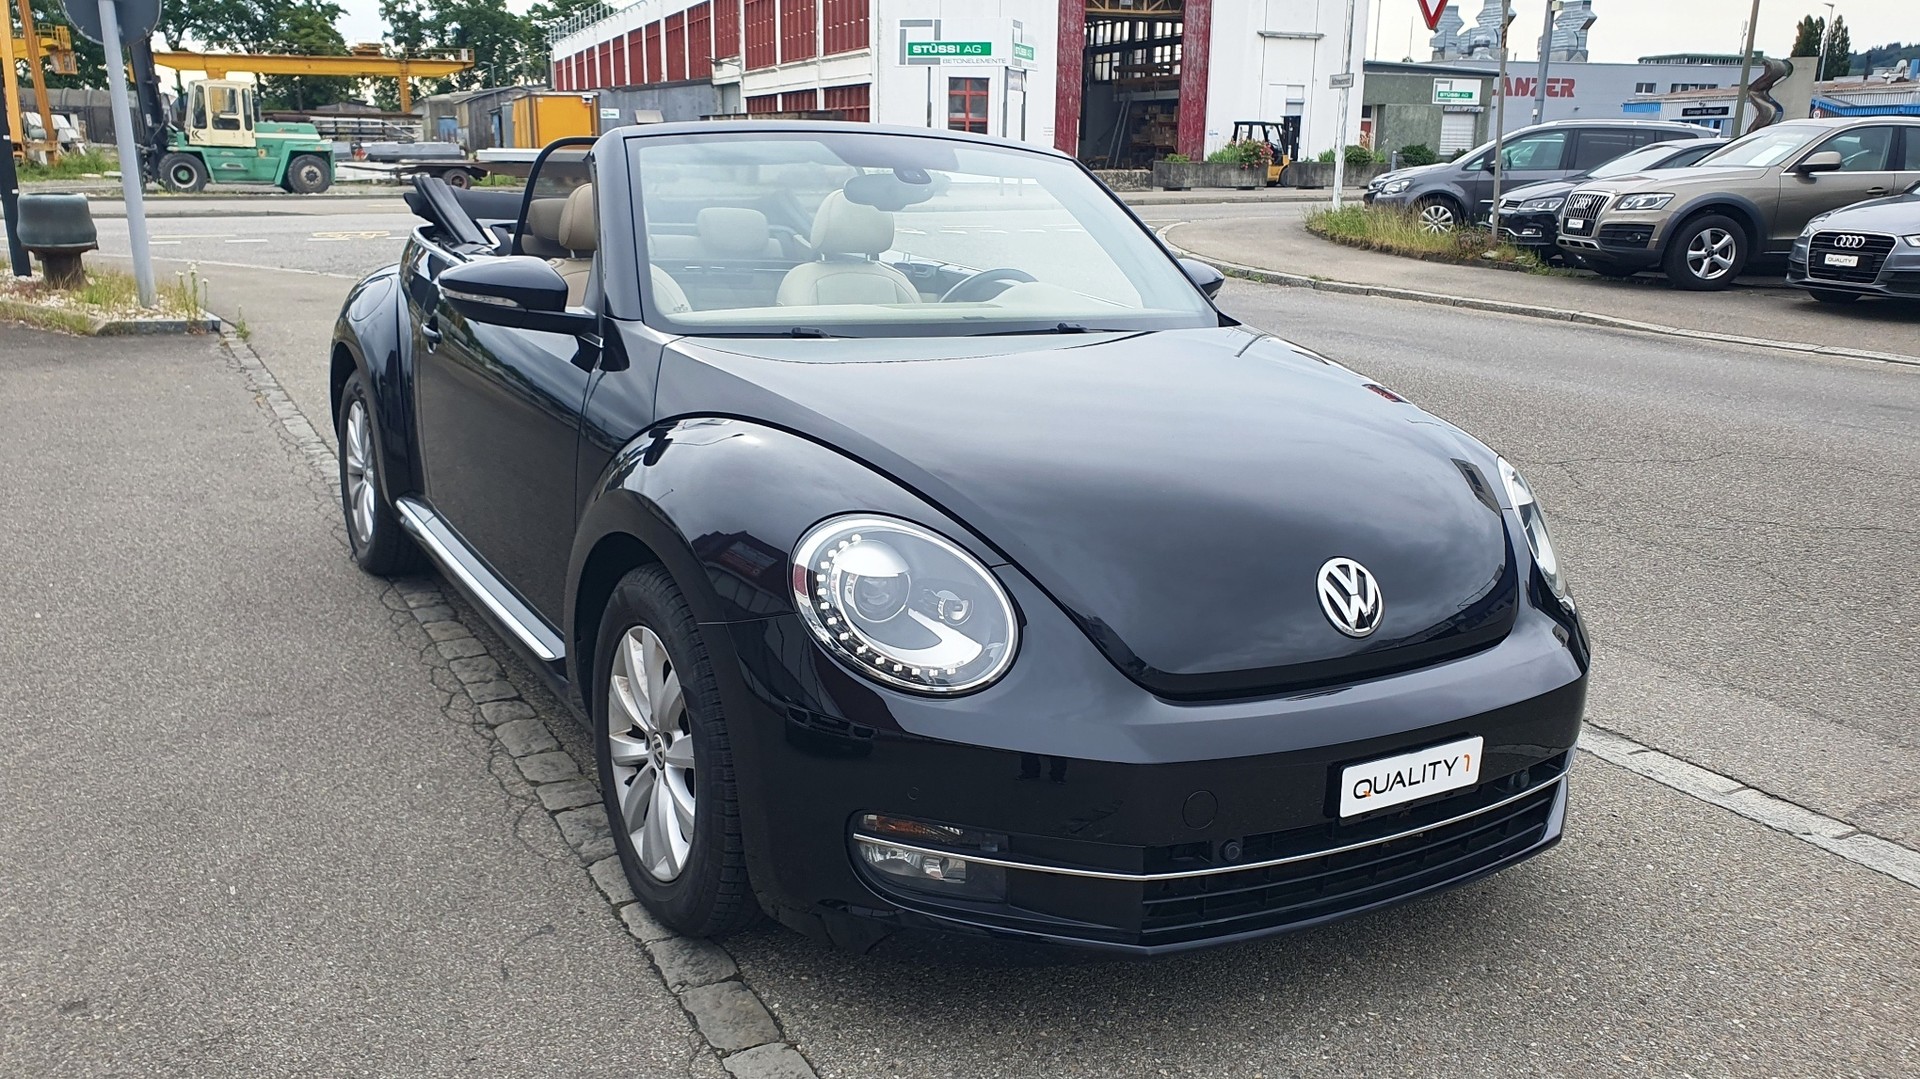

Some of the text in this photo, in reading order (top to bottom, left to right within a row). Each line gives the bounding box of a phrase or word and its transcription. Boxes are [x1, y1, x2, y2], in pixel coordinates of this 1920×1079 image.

[912, 43, 982, 54] STÜSSI AG
[1827, 256, 1852, 264] QUALITY
[1353, 753, 1471, 800] QUALITY 1
